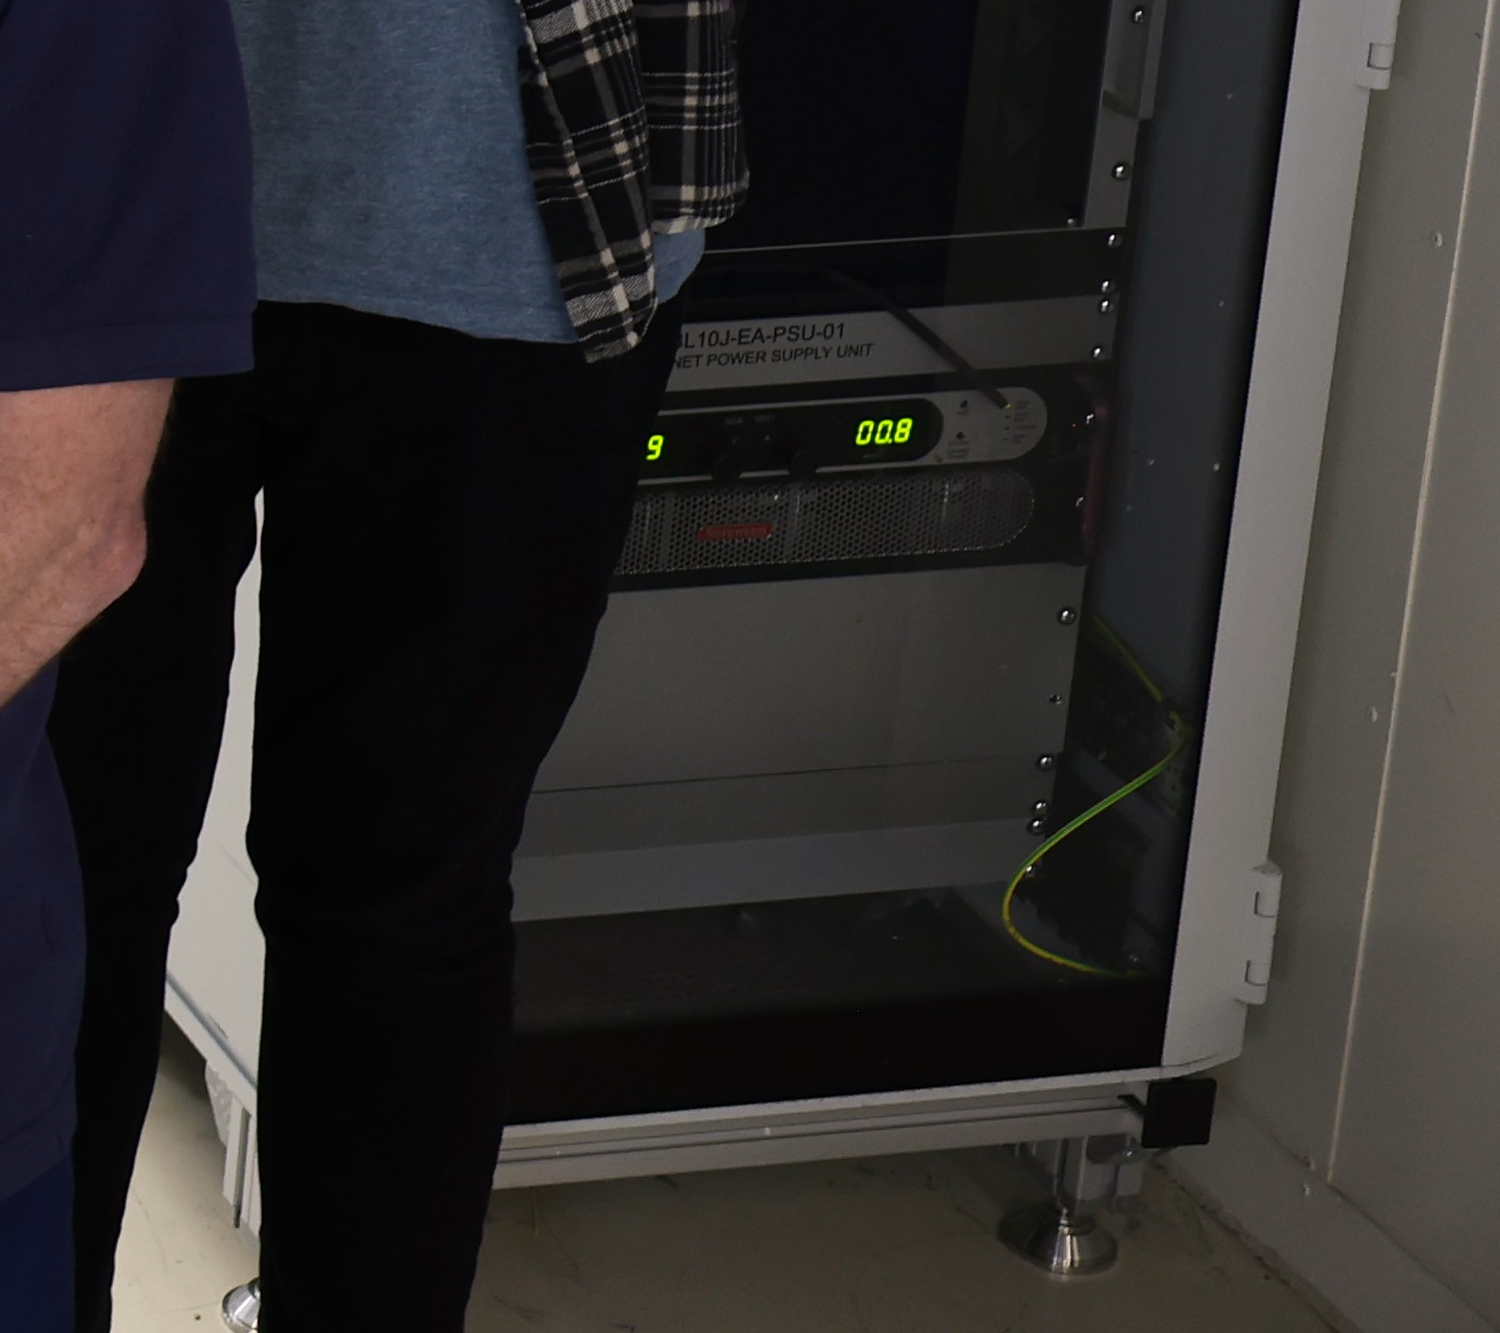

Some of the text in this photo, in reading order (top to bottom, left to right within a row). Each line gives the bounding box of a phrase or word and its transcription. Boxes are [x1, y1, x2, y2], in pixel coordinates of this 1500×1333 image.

[679, 322, 845, 350] L10J-EA-PSU-01
[707, 351, 767, 368] POWER
[772, 346, 832, 363] SUPPLY
[837, 343, 875, 360] UNIT
[855, 418, 913, 446] 00.8
